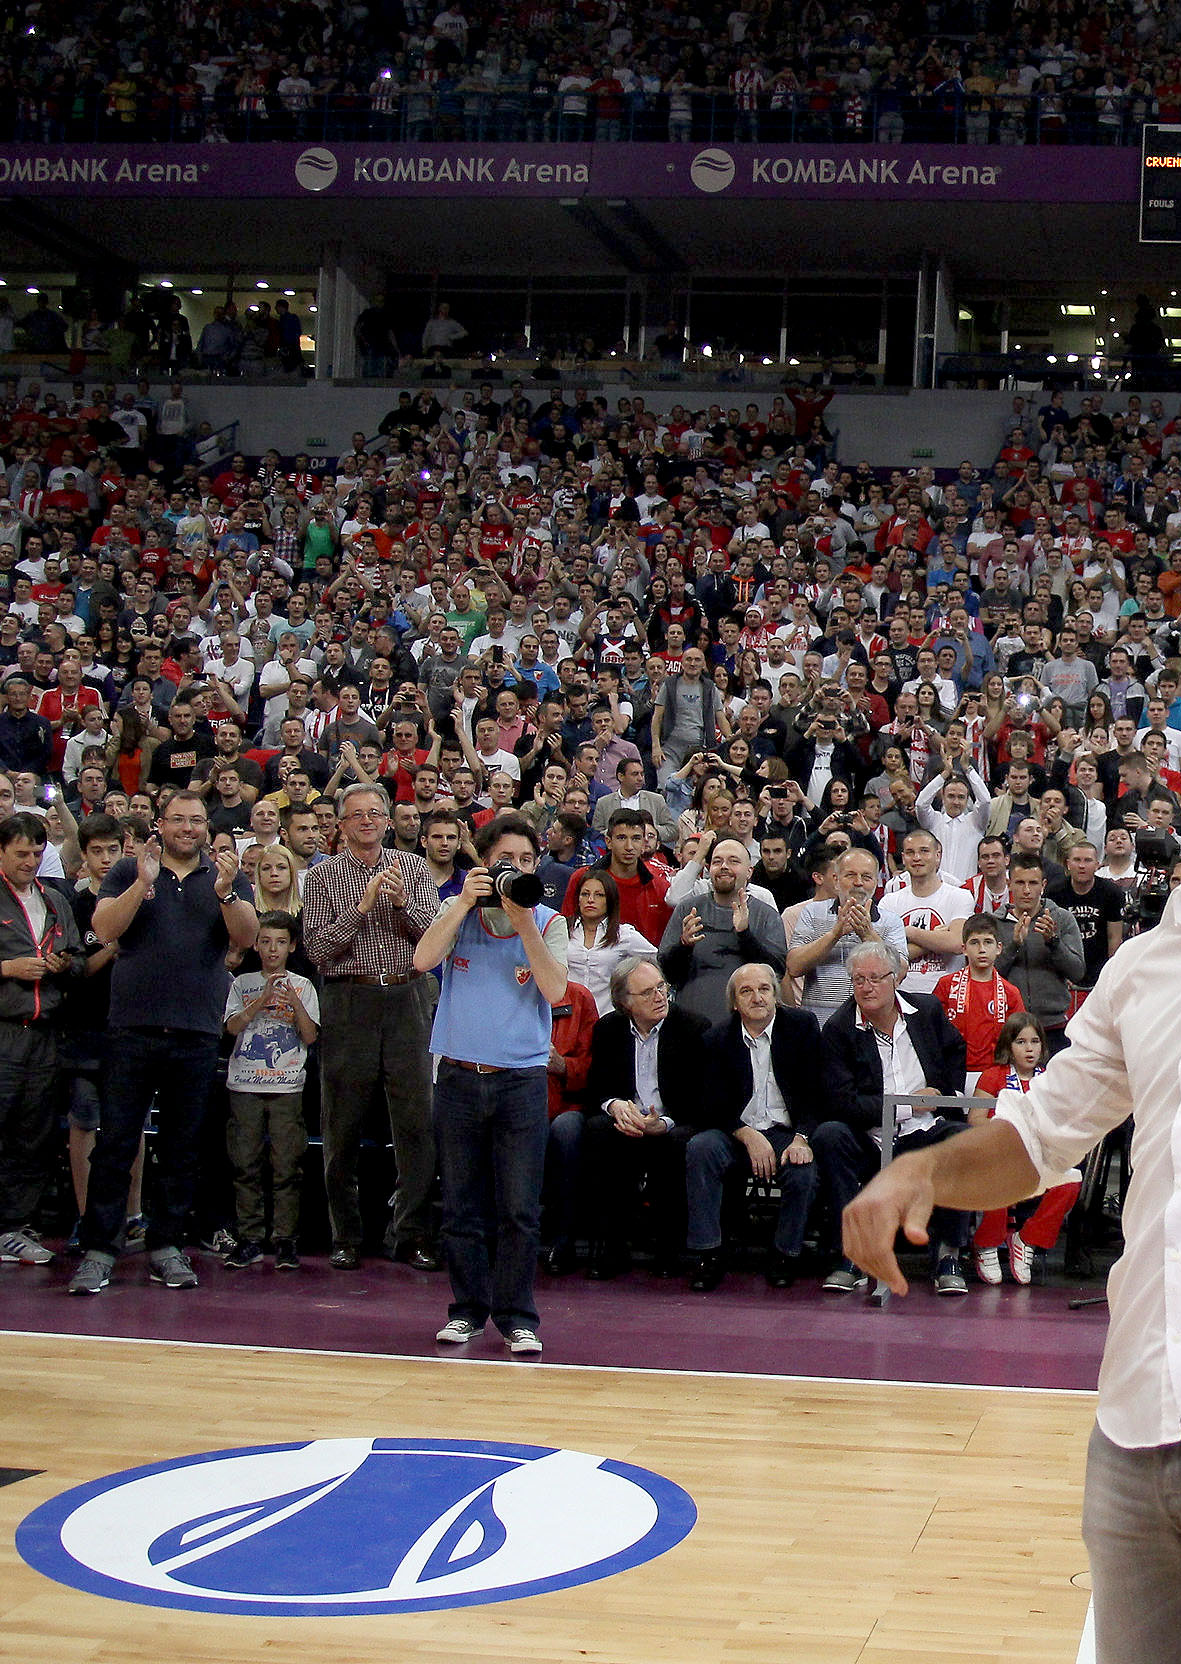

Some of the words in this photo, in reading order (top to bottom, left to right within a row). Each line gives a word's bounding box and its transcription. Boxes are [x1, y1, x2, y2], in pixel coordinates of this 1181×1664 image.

[0, 158, 108, 182] OMBANK
[115, 158, 199, 182] Arena
[353, 158, 495, 182] KOMBANK
[501, 158, 589, 182] Arena
[752, 158, 900, 184] KOMBANK
[906, 159, 996, 185] Arena
[1149, 200, 1175, 209] FOULS
